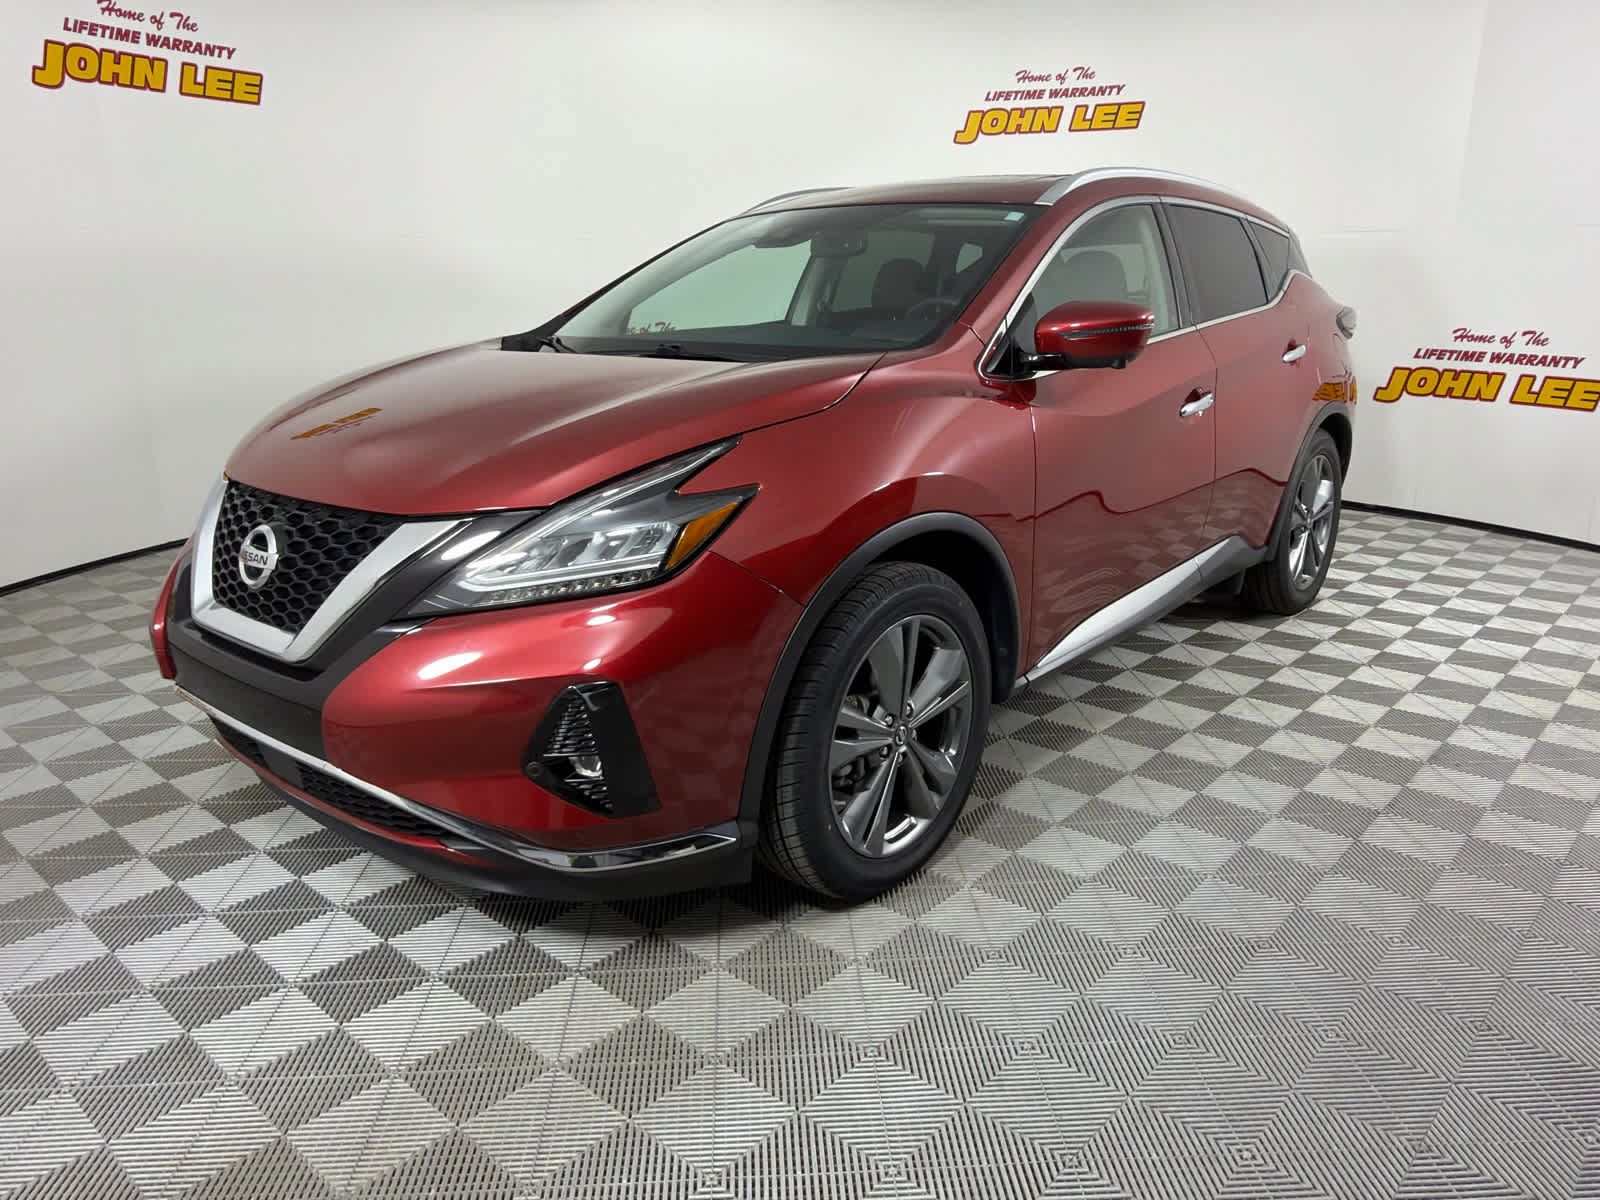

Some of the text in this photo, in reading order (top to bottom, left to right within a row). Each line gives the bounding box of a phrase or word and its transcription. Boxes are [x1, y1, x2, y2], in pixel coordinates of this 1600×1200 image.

[97, 0, 199, 32] Home of The
[63, 17, 236, 60] LIFETIME WARRANTY
[32, 39, 263, 105] JOHN LEE
[1016, 67, 1095, 84] Home of The
[985, 84, 1126, 101] LIFETIME WARRANTY
[954, 101, 1145, 144] JOHN LEE
[1452, 327, 1550, 348] Home of The
[1414, 348, 1584, 368] LIFETIME WARRANTY
[1374, 367, 1506, 402] JOHN
[1510, 375, 1600, 411] LEE
